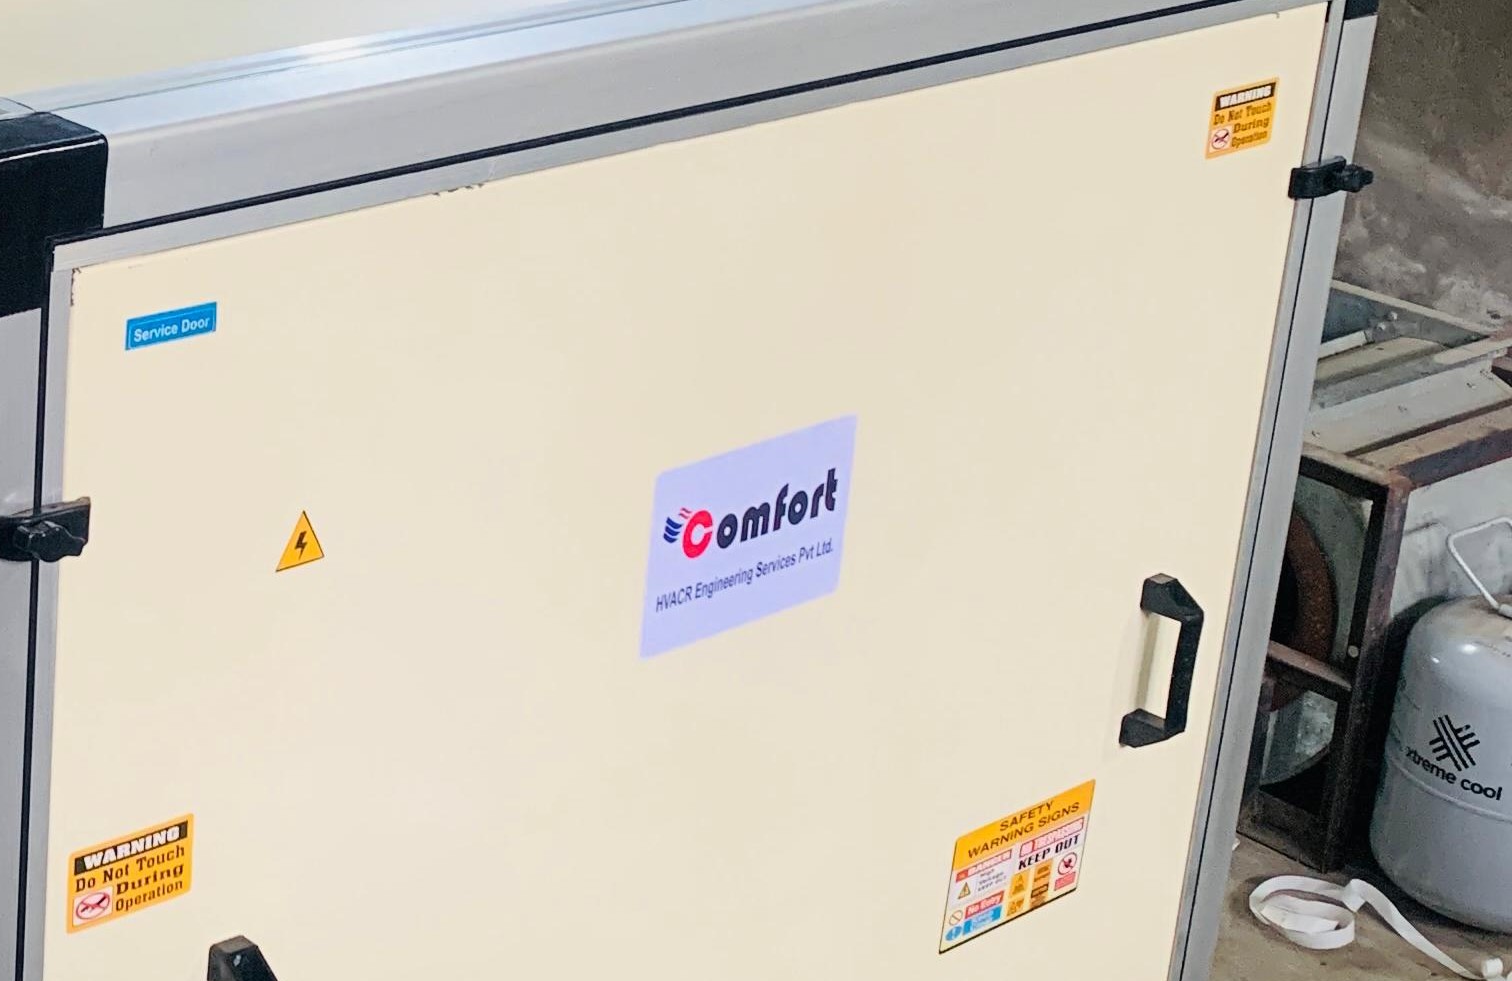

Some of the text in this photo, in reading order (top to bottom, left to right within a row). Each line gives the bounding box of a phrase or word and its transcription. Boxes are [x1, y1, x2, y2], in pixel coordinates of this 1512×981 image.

[1220, 86, 1271, 108] WARNING
[1214, 114, 1224, 125] Do
[1228, 110, 1243, 122] Not
[1233, 117, 1269, 134] During
[133, 317, 210, 343] Service Door
[682, 468, 838, 559] Comfort
[655, 538, 834, 613] HVACR Engineering Services Pvt Ltd.
[1404, 746, 1503, 801] xtreme cool
[968, 822, 1034, 858] WARNING
[1038, 802, 1079, 827] SIGNS
[1000, 801, 1053, 831] SAFETY
[84, 826, 179, 869] WARNING
[1019, 848, 1050, 870] KEEP
[1055, 835, 1079, 853] OUT
[76, 845, 184, 892] Do Not Touch
[117, 864, 183, 895] During
[116, 881, 182, 911] Operation
